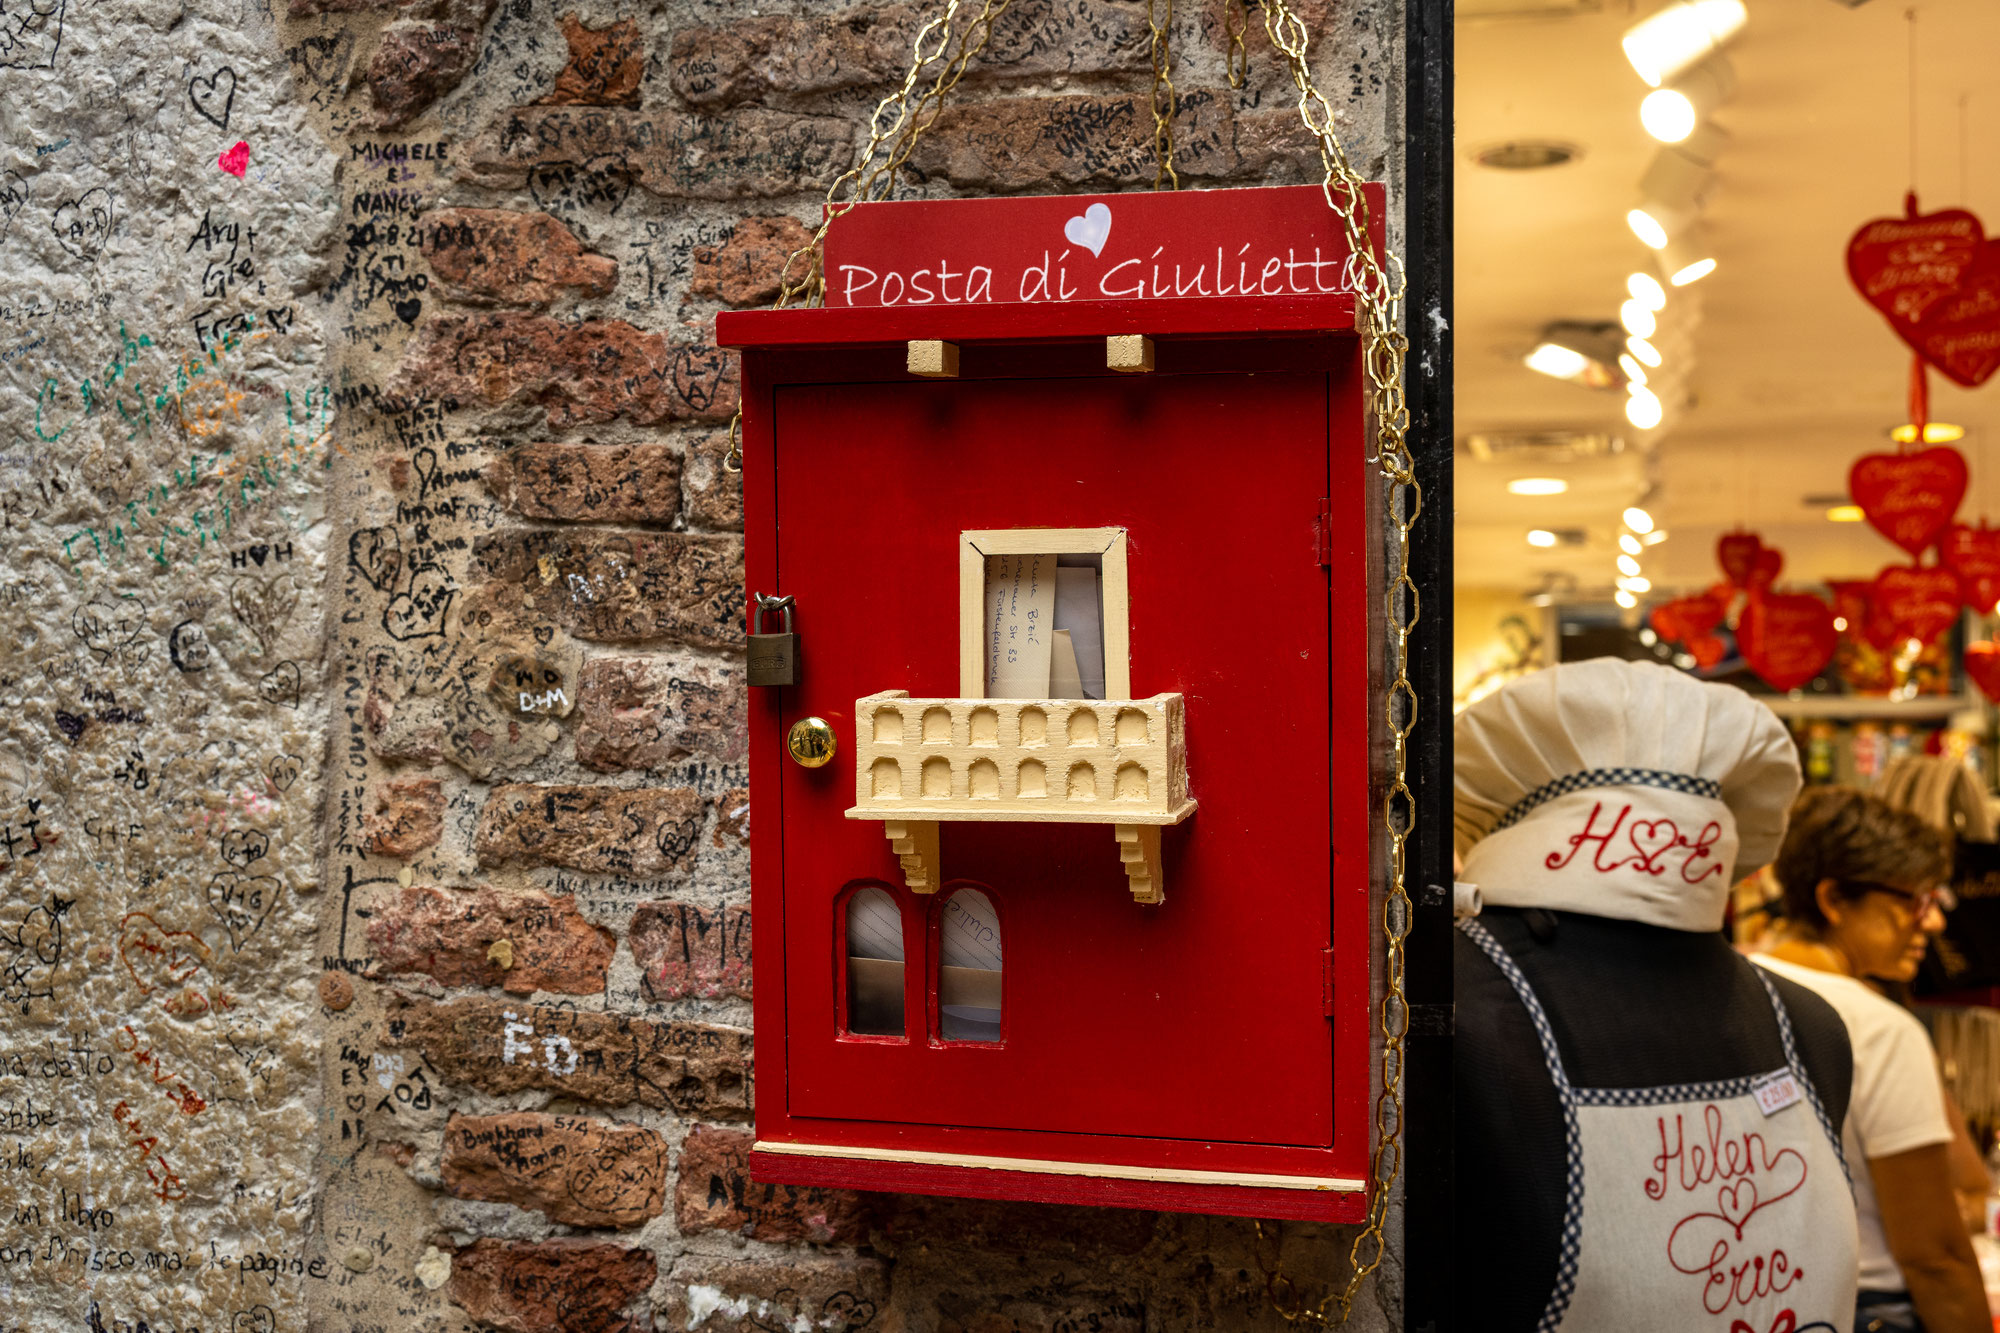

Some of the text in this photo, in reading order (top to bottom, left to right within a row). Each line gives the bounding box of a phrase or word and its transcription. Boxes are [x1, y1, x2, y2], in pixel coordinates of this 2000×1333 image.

[352, 141, 448, 162] MICHELE
[352, 193, 422, 220] NANCY
[839, 243, 1369, 306] Posta di Giulietta
[1645, 1104, 1776, 1201] Helen
[61, 1188, 114, 1232] libro
[145, 1248, 191, 1270] mai
[240, 1250, 328, 1287] pagine
[1703, 1239, 1803, 1315] Eric
